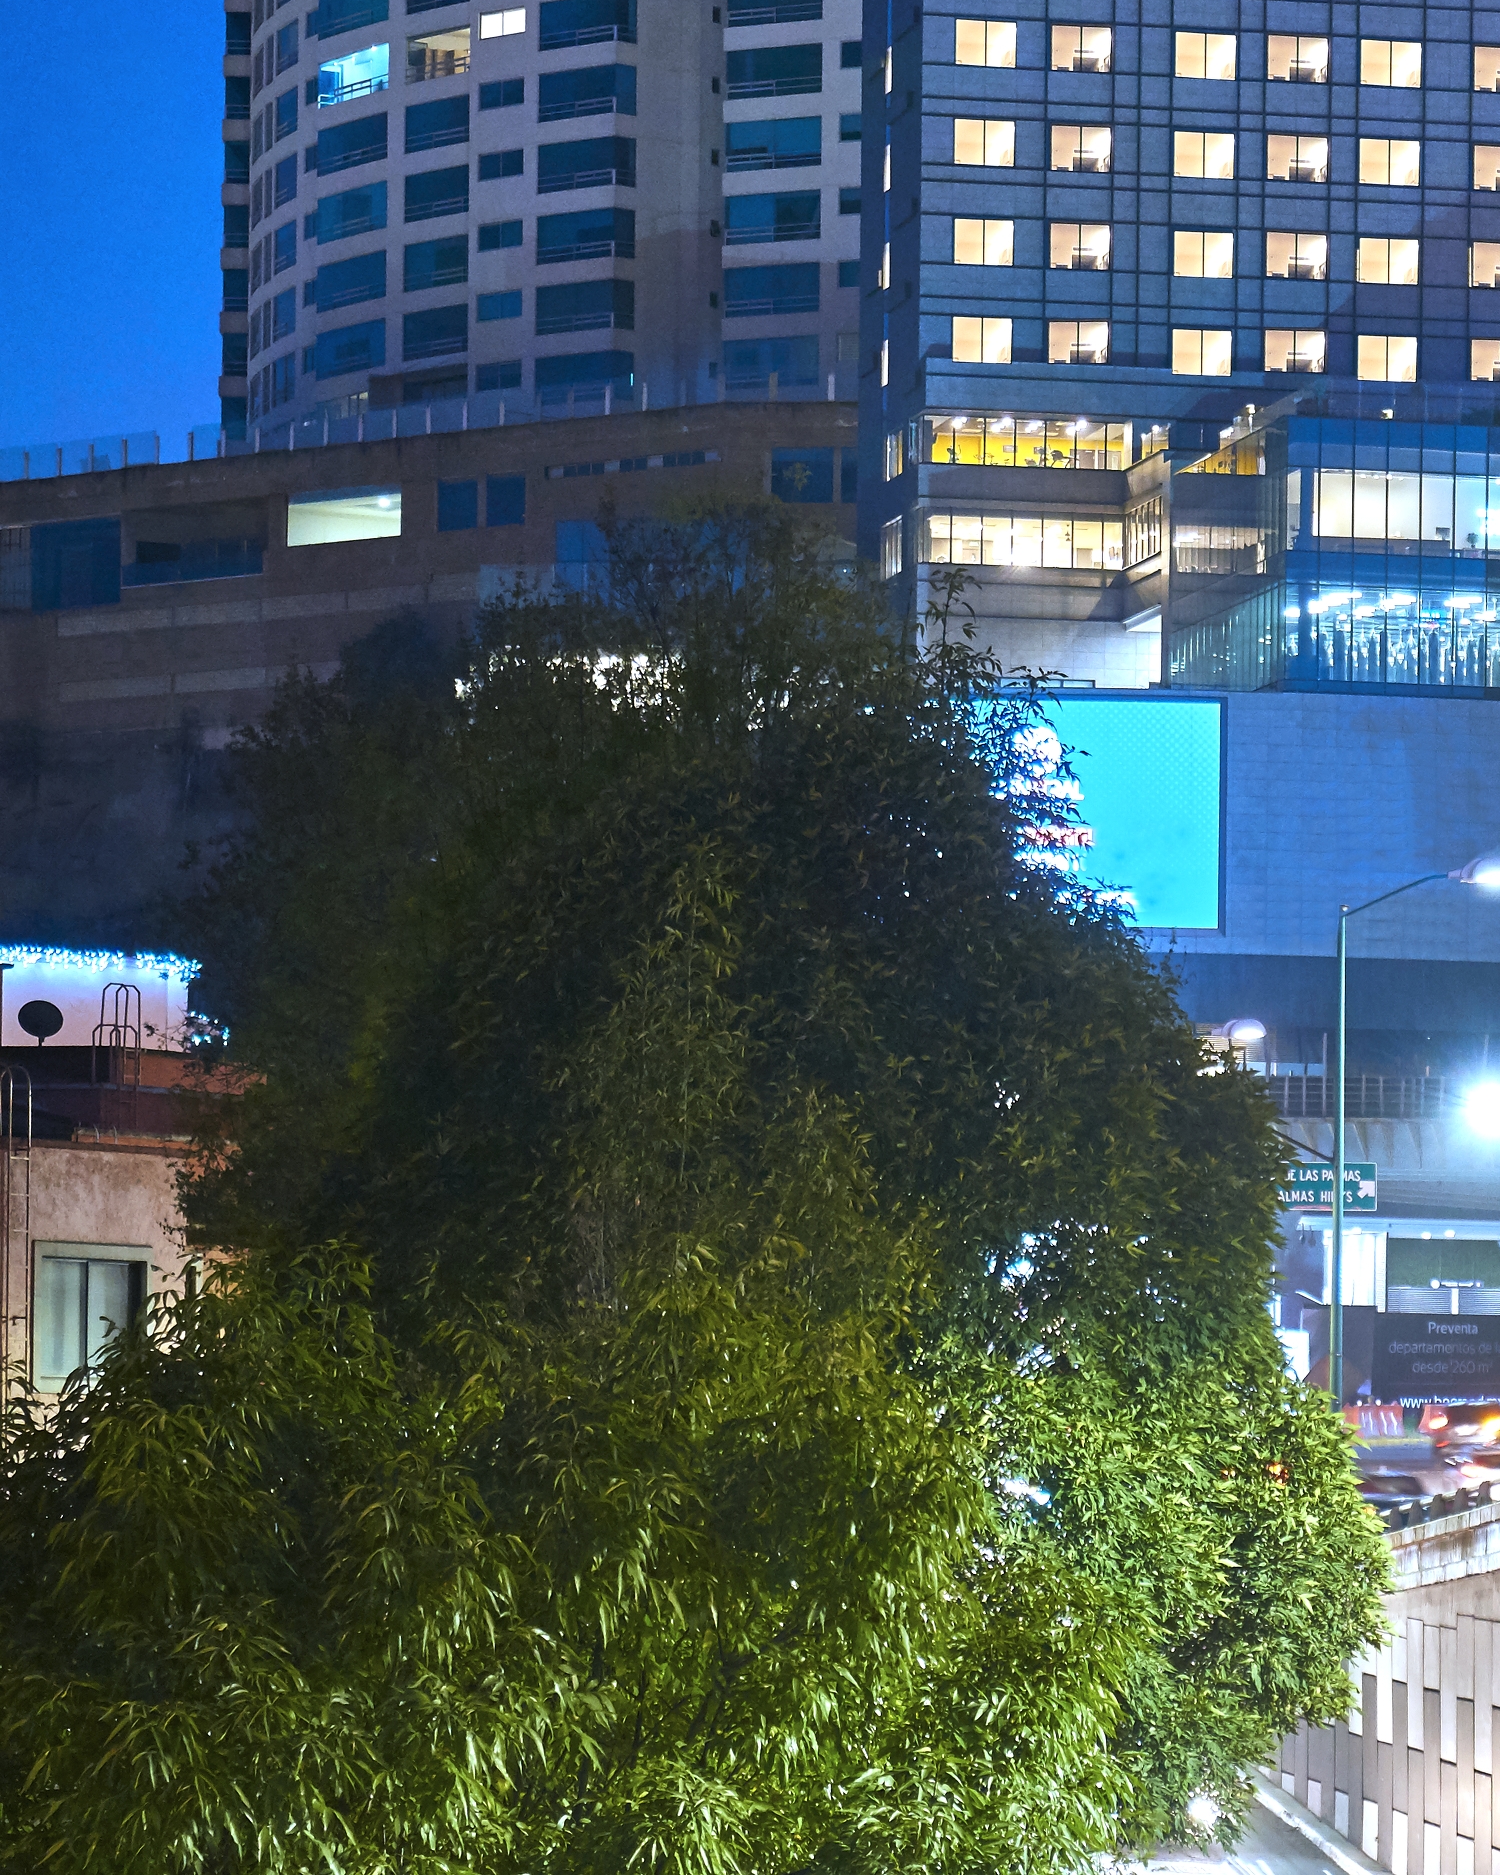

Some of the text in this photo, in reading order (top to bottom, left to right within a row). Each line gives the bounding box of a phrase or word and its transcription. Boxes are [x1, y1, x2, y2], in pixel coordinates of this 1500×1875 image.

[1300, 1169, 1319, 1182] LAS
[1322, 1169, 1361, 1182] PAAS
[1428, 1321, 1479, 1335] Preventa
[1478, 1342, 1492, 1354] de
[1412, 1361, 1449, 1374] desde
